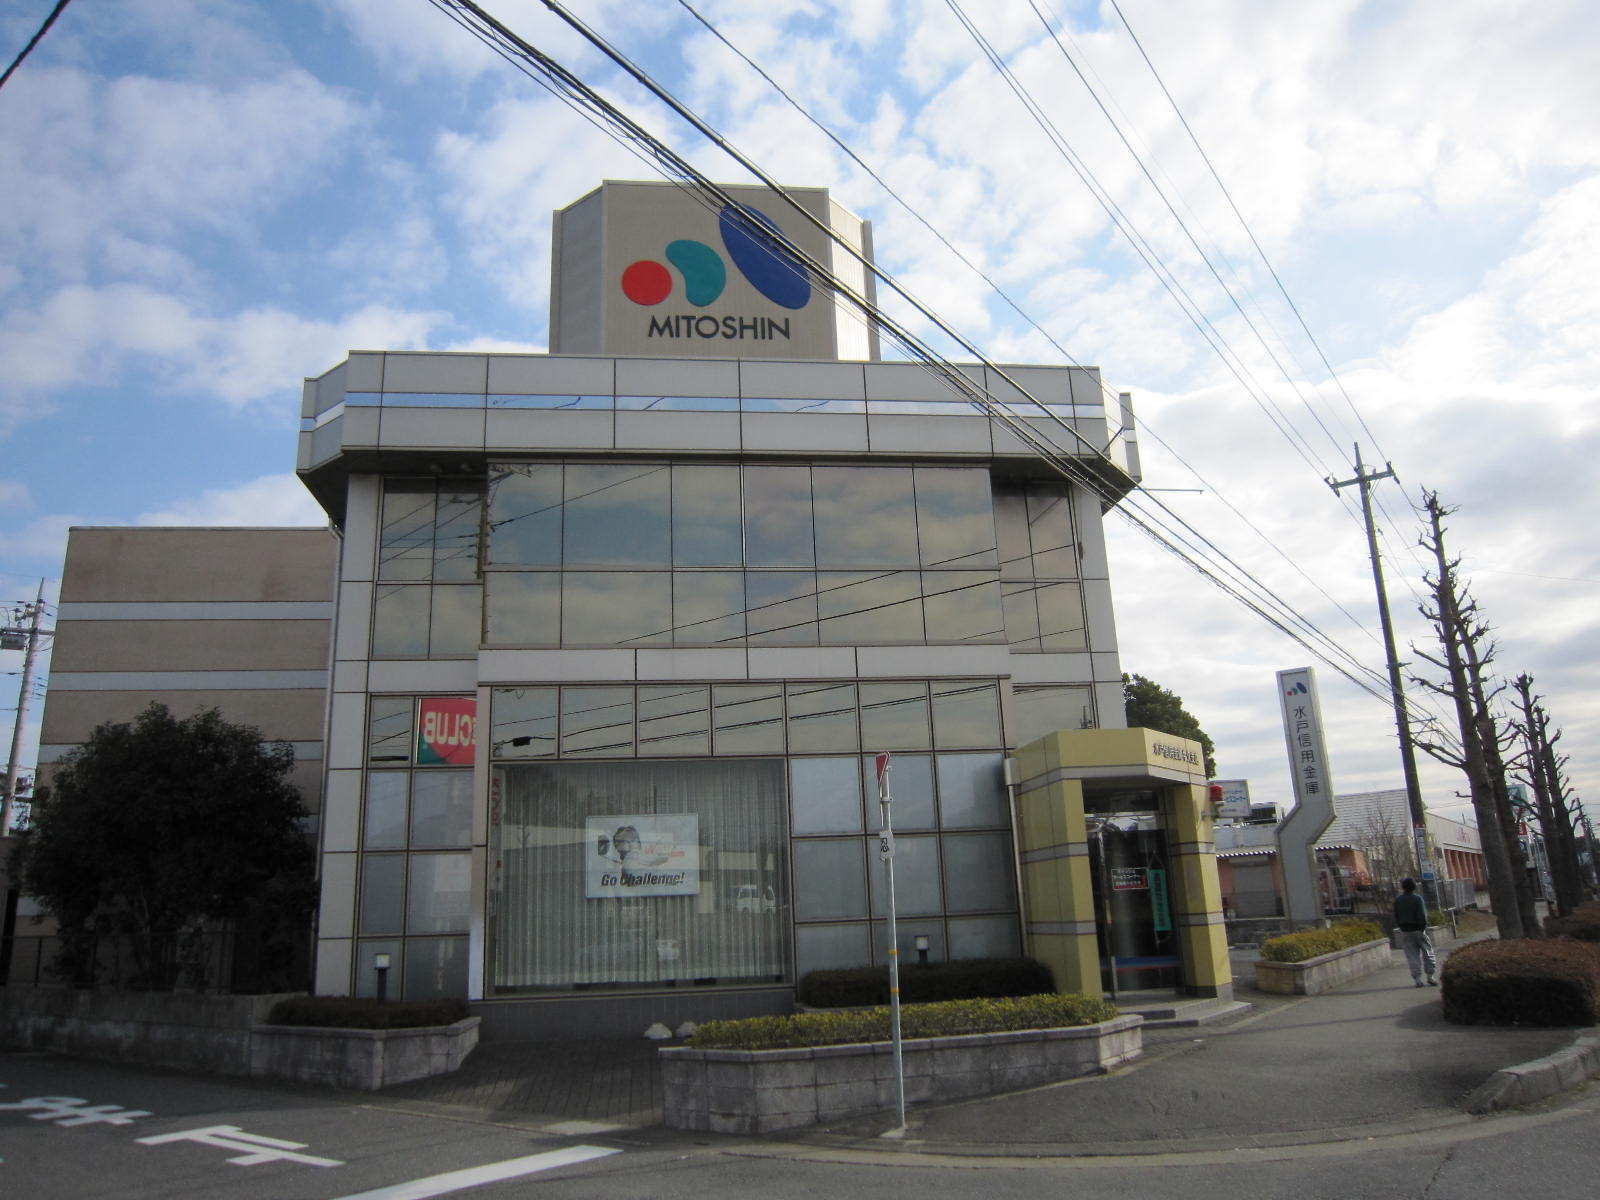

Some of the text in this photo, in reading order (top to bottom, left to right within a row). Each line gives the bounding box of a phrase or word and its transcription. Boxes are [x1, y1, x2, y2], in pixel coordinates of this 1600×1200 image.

[648, 315, 790, 340] MITOSHIN
[1294, 705, 1319, 795] 水戸信用金庫
[601, 873, 618, 887] Go
